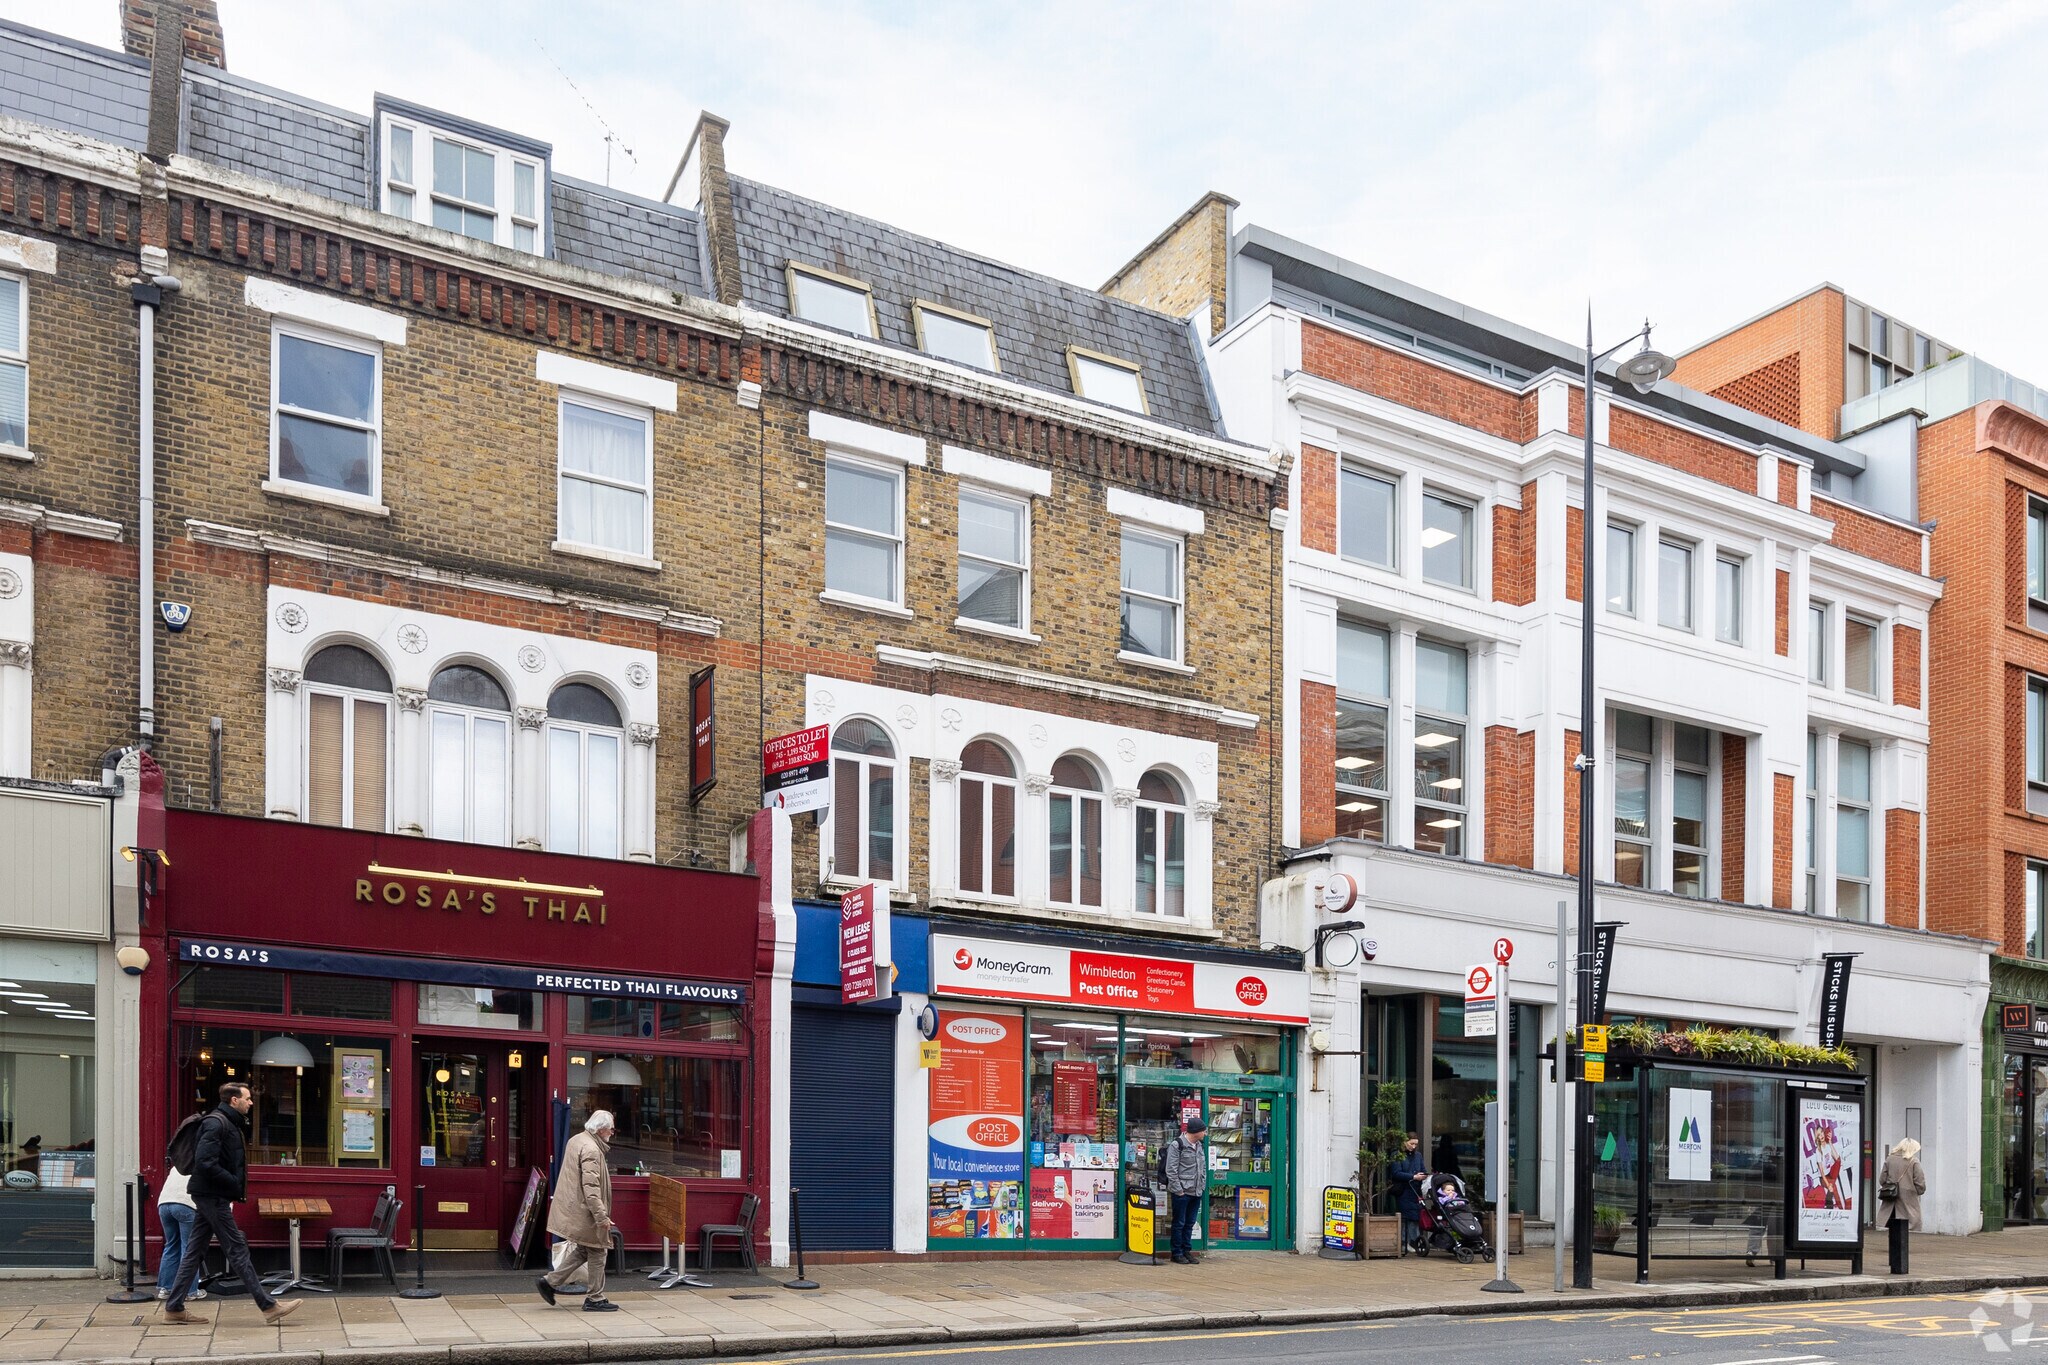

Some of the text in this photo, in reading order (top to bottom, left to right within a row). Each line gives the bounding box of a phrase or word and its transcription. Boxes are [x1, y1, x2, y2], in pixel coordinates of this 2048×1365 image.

[699, 733, 710, 747] THAI
[765, 727, 827, 754] OFFICES TO LET
[786, 788, 818, 801] andrew scott
[786, 799, 810, 809] robertson
[355, 878, 607, 926] ROSA'S THAI
[843, 921, 871, 940] NEW LEASE
[190, 944, 269, 963] ROSA'S
[1496, 940, 1508, 958] R
[976, 957, 1052, 976] MoneyGram
[1079, 963, 1137, 981] Wimbledon
[1146, 966, 1184, 979] Confectionery
[976, 973, 1030, 985] money transfer
[1146, 976, 1187, 988] Greeting Cards
[536, 974, 739, 1000] PERFECTED THAI FLAVOURS
[1079, 981, 1139, 999] Post Office
[1146, 985, 1175, 996] Stationery
[1242, 982, 1263, 993] POST
[1147, 994, 1160, 1004] Toys
[1238, 990, 1265, 1001] OFFICE
[952, 1025, 1001, 1036] POST OFFICE
[436, 1090, 471, 1098] ROSA'S
[442, 1097, 465, 1105] THAI
[1806, 1102, 1853, 1113] LULU GUINNESS
[979, 1123, 1009, 1133] POST
[975, 1132, 1009, 1142] OFFICE
[1678, 1143, 1702, 1151] MERTON
[932, 1152, 1020, 1173] Your local convenience store
[1032, 1192, 1047, 1200] day
[1074, 1190, 1090, 1198] Pay
[1326, 1191, 1353, 1202] CARTRIDGE
[1031, 1200, 1064, 1209] delivery
[1332, 1200, 1346, 1209] REFILL
[1130, 1215, 1149, 1223] Available
